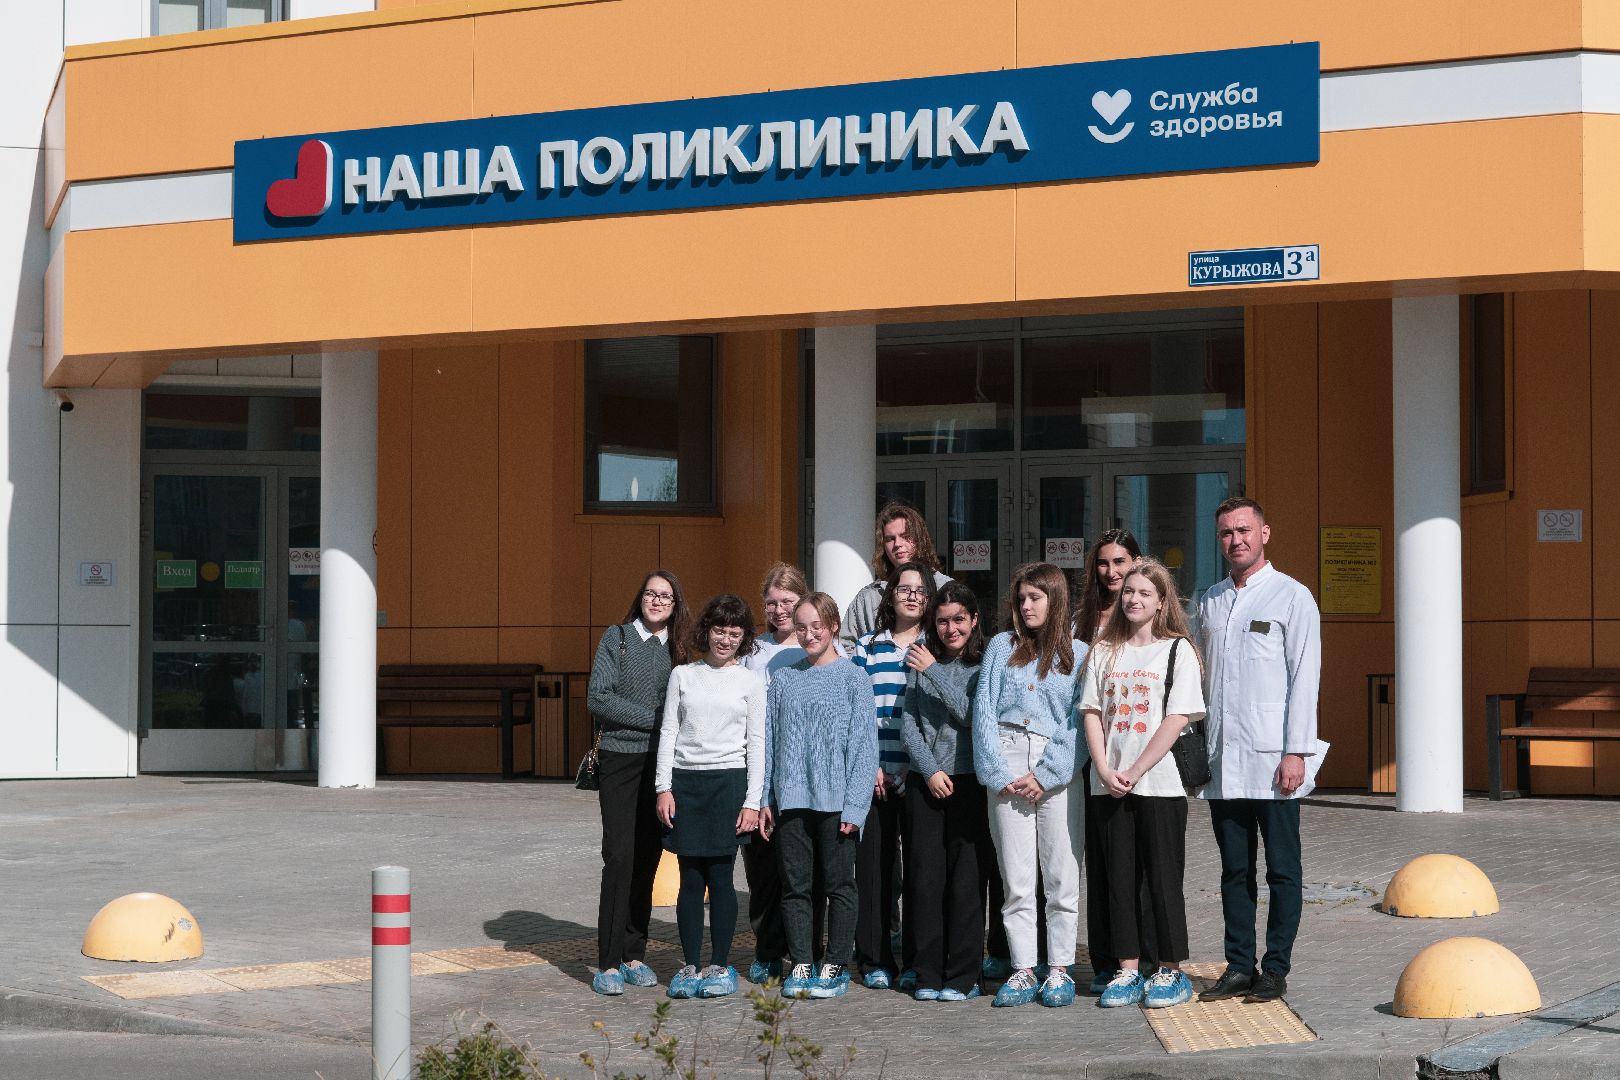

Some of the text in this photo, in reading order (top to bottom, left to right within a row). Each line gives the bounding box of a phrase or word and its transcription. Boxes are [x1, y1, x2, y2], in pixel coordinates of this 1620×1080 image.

[1149, 82, 1259, 117] Служба
[1149, 110, 1284, 138] здоровья
[344, 101, 1030, 205] НАША ПОЛИКЛИНИКА
[1192, 262, 1282, 279] КУРЫЖОВА
[1193, 256, 1219, 265] улица
[163, 565, 192, 576] Вход
